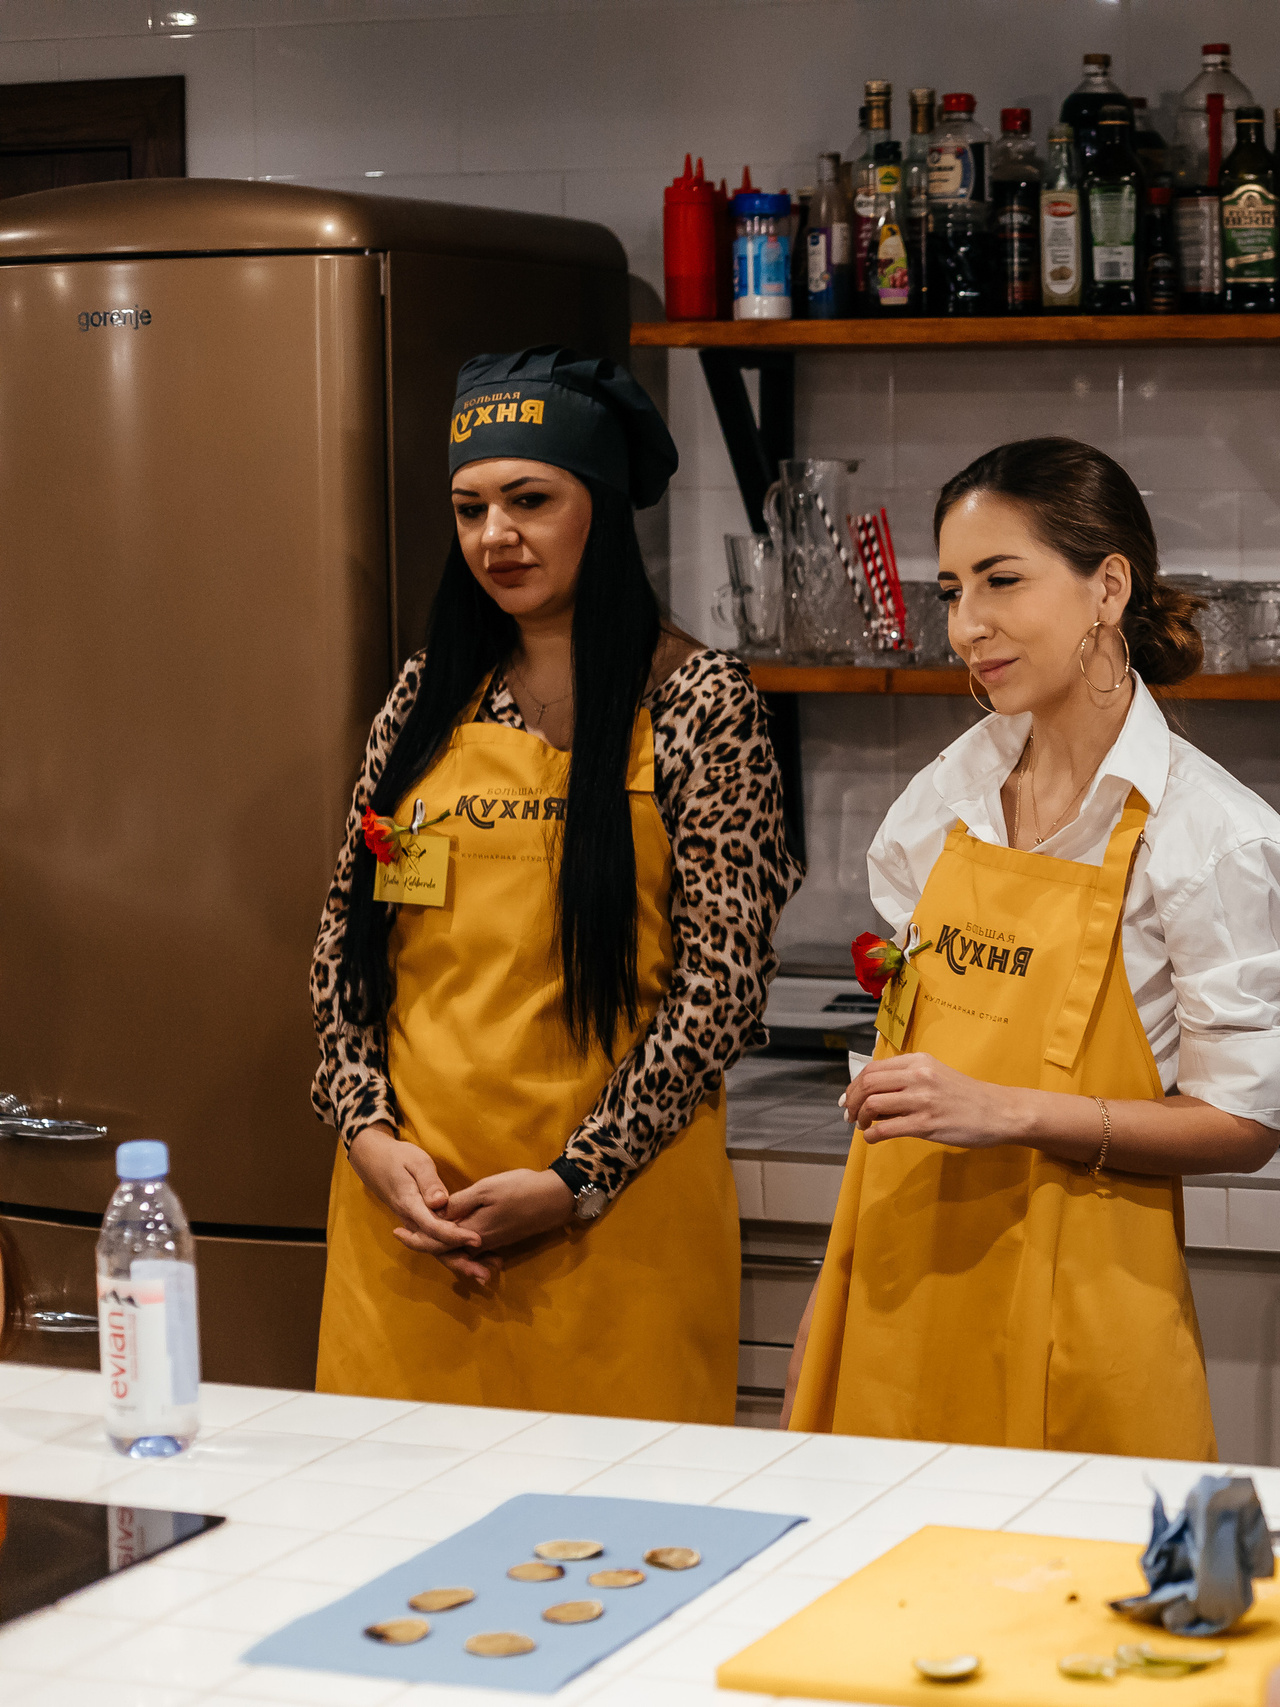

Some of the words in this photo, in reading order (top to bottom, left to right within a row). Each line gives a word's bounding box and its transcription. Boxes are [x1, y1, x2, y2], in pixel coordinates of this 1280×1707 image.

[78, 304, 151, 331] gorenje
[463, 391, 521, 409] БОЛЬШАЯ
[450, 399, 545, 444] КУХНЯ
[486, 787, 543, 796] БОЛЬШАЯ
[455, 795, 567, 829] КУХНЯ
[461, 852, 517, 861] КУЛИНАРНАЯ
[935, 924, 1034, 977] КУХНЯ
[923, 994, 976, 1016] КУЛИНАРНАЯ
[978, 1012, 1009, 1024] СТУДИЯ
[108, 1311, 129, 1399] evian
